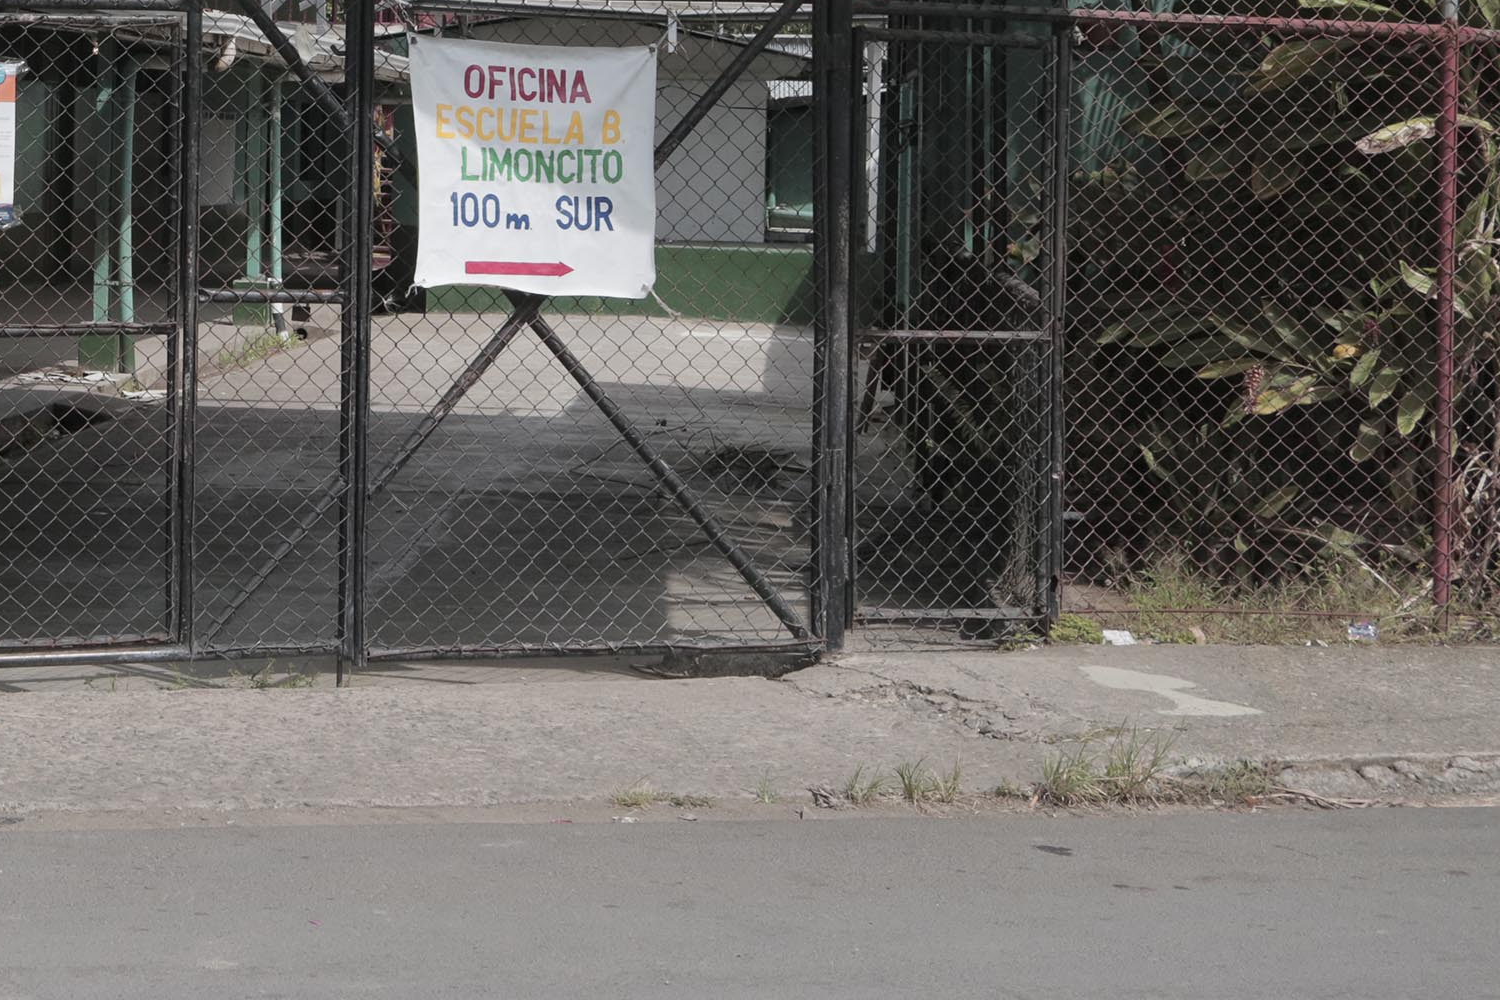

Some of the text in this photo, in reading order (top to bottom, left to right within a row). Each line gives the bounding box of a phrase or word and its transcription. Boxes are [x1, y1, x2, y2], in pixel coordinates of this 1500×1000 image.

[464, 64, 592, 104] OFICINA
[436, 104, 584, 144] ESCUELA
[461, 146, 623, 184] LIMONCITO
[556, 196, 614, 231] SUR
